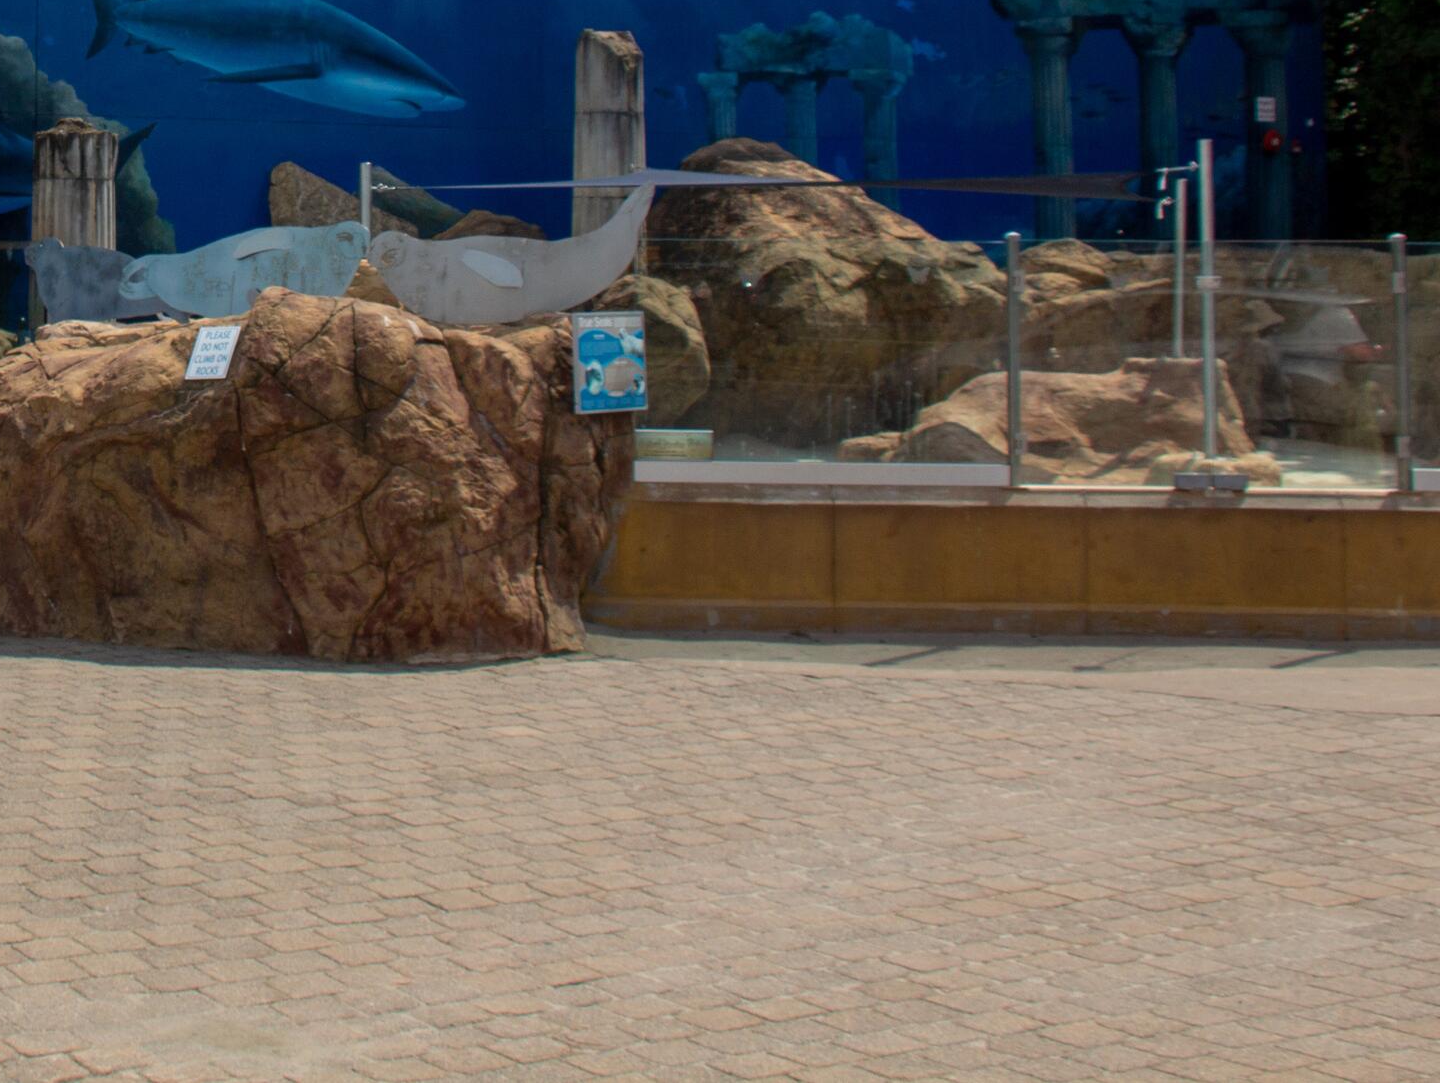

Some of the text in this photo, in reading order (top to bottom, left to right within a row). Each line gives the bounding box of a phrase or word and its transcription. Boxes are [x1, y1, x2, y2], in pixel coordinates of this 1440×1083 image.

[205, 330, 232, 339] PLEASE
[201, 342, 229, 351] DO NOT
